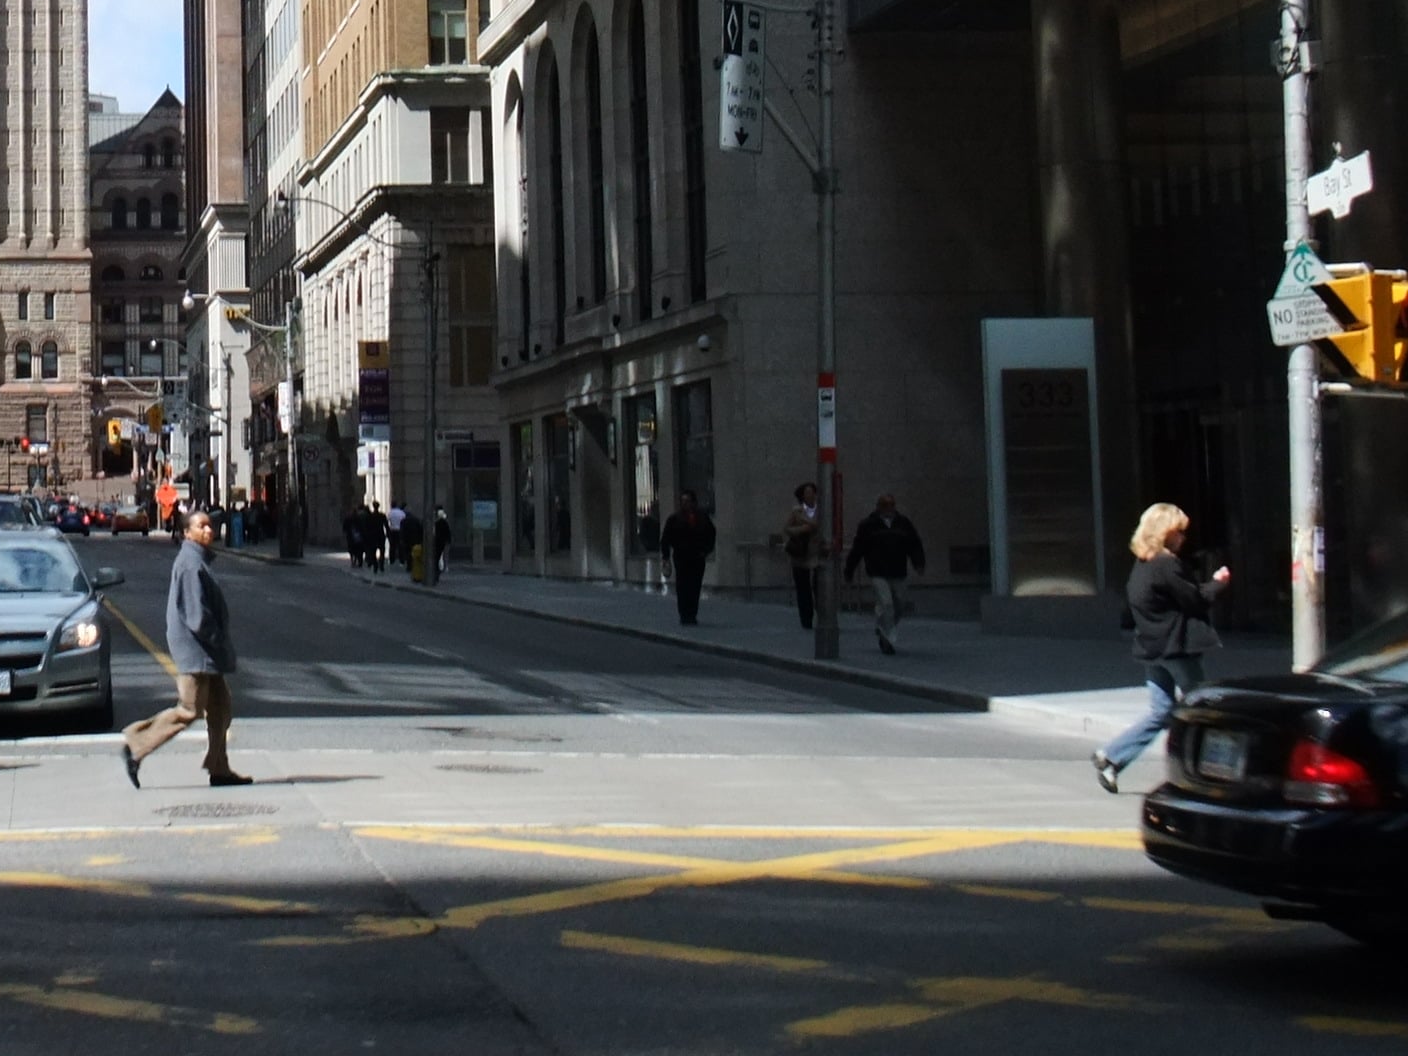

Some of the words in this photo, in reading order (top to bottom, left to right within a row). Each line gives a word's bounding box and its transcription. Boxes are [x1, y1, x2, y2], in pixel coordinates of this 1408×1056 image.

[1324, 175, 1341, 197] Bay
[1342, 167, 1353, 189] St
[1273, 308, 1293, 325] NO
